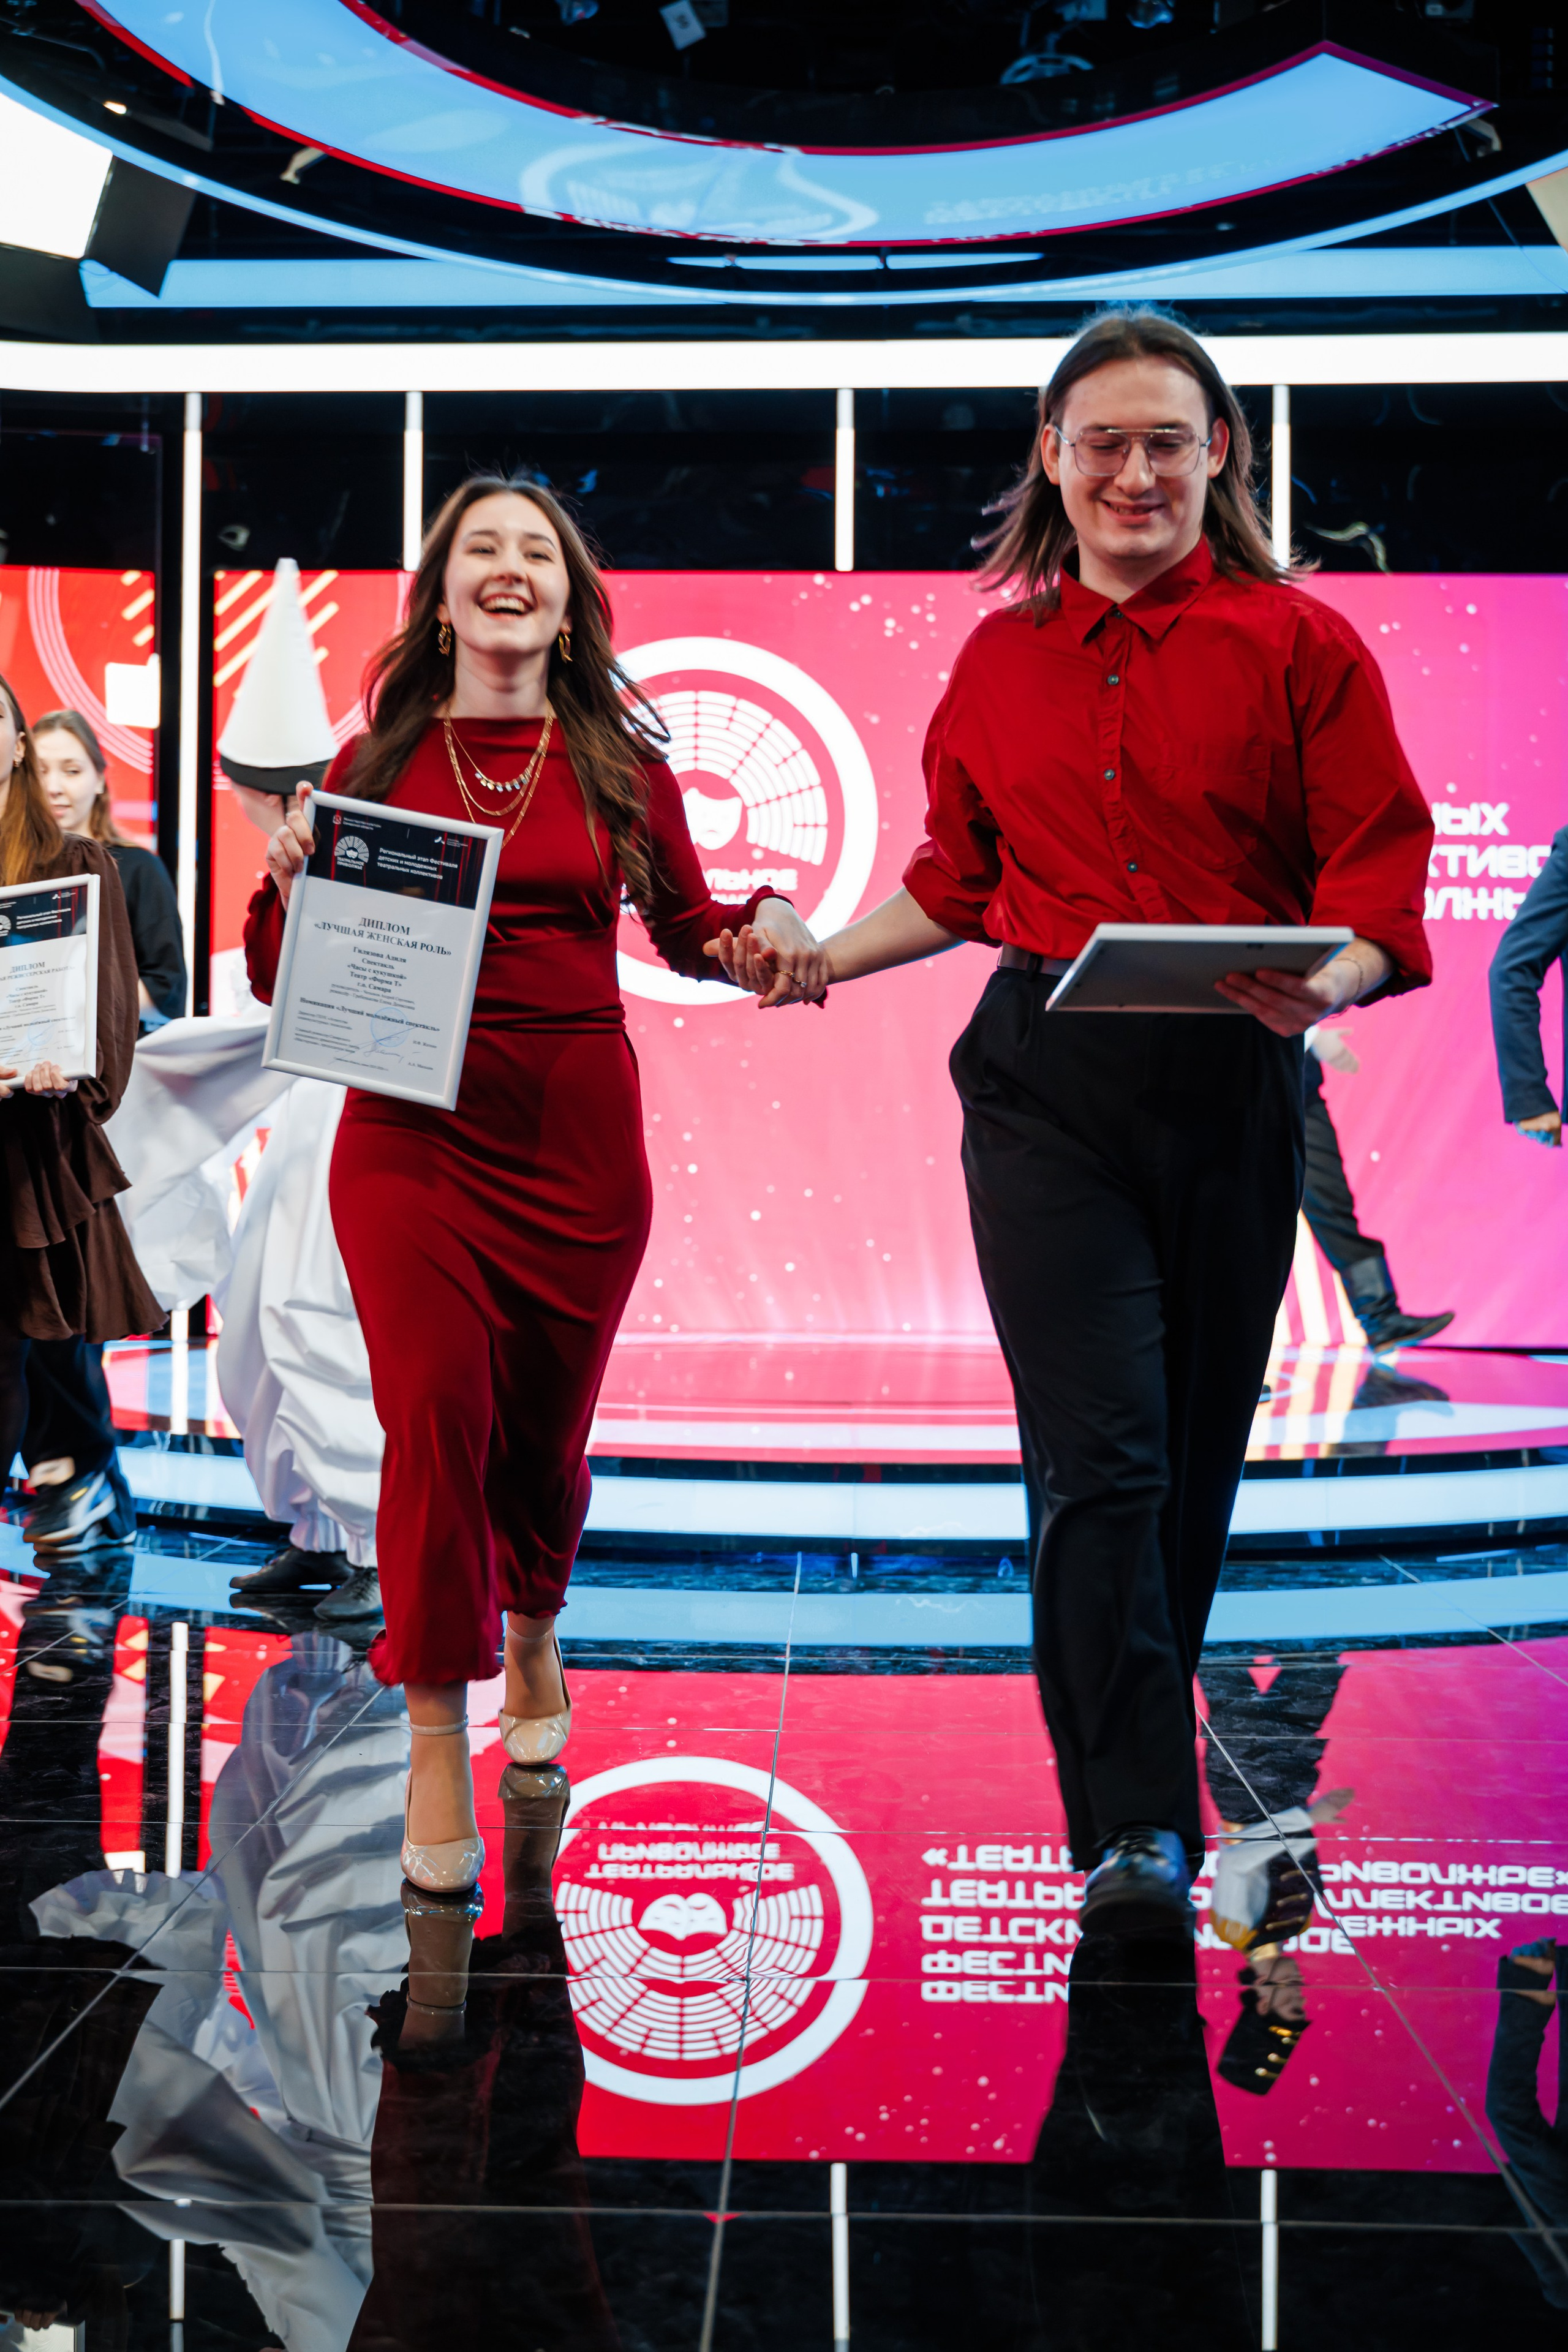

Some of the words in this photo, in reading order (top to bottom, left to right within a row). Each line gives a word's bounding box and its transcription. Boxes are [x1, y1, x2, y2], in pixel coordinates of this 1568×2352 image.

[1430, 802, 1510, 835] ЫХ
[378, 855, 398, 864] детских
[404, 861, 437, 870] молодежных
[379, 848, 416, 859] Региональный
[429, 859, 458, 868] Фестиваля
[377, 862, 409, 872] театральных
[410, 870, 442, 879] коллективов
[359, 918, 410, 935] ДИПЛОМ
[314, 921, 363, 937] «ЛУЧШАЯ
[367, 932, 418, 948] ЖЕНСКАЯ
[420, 943, 451, 956] РОЛЬ»
